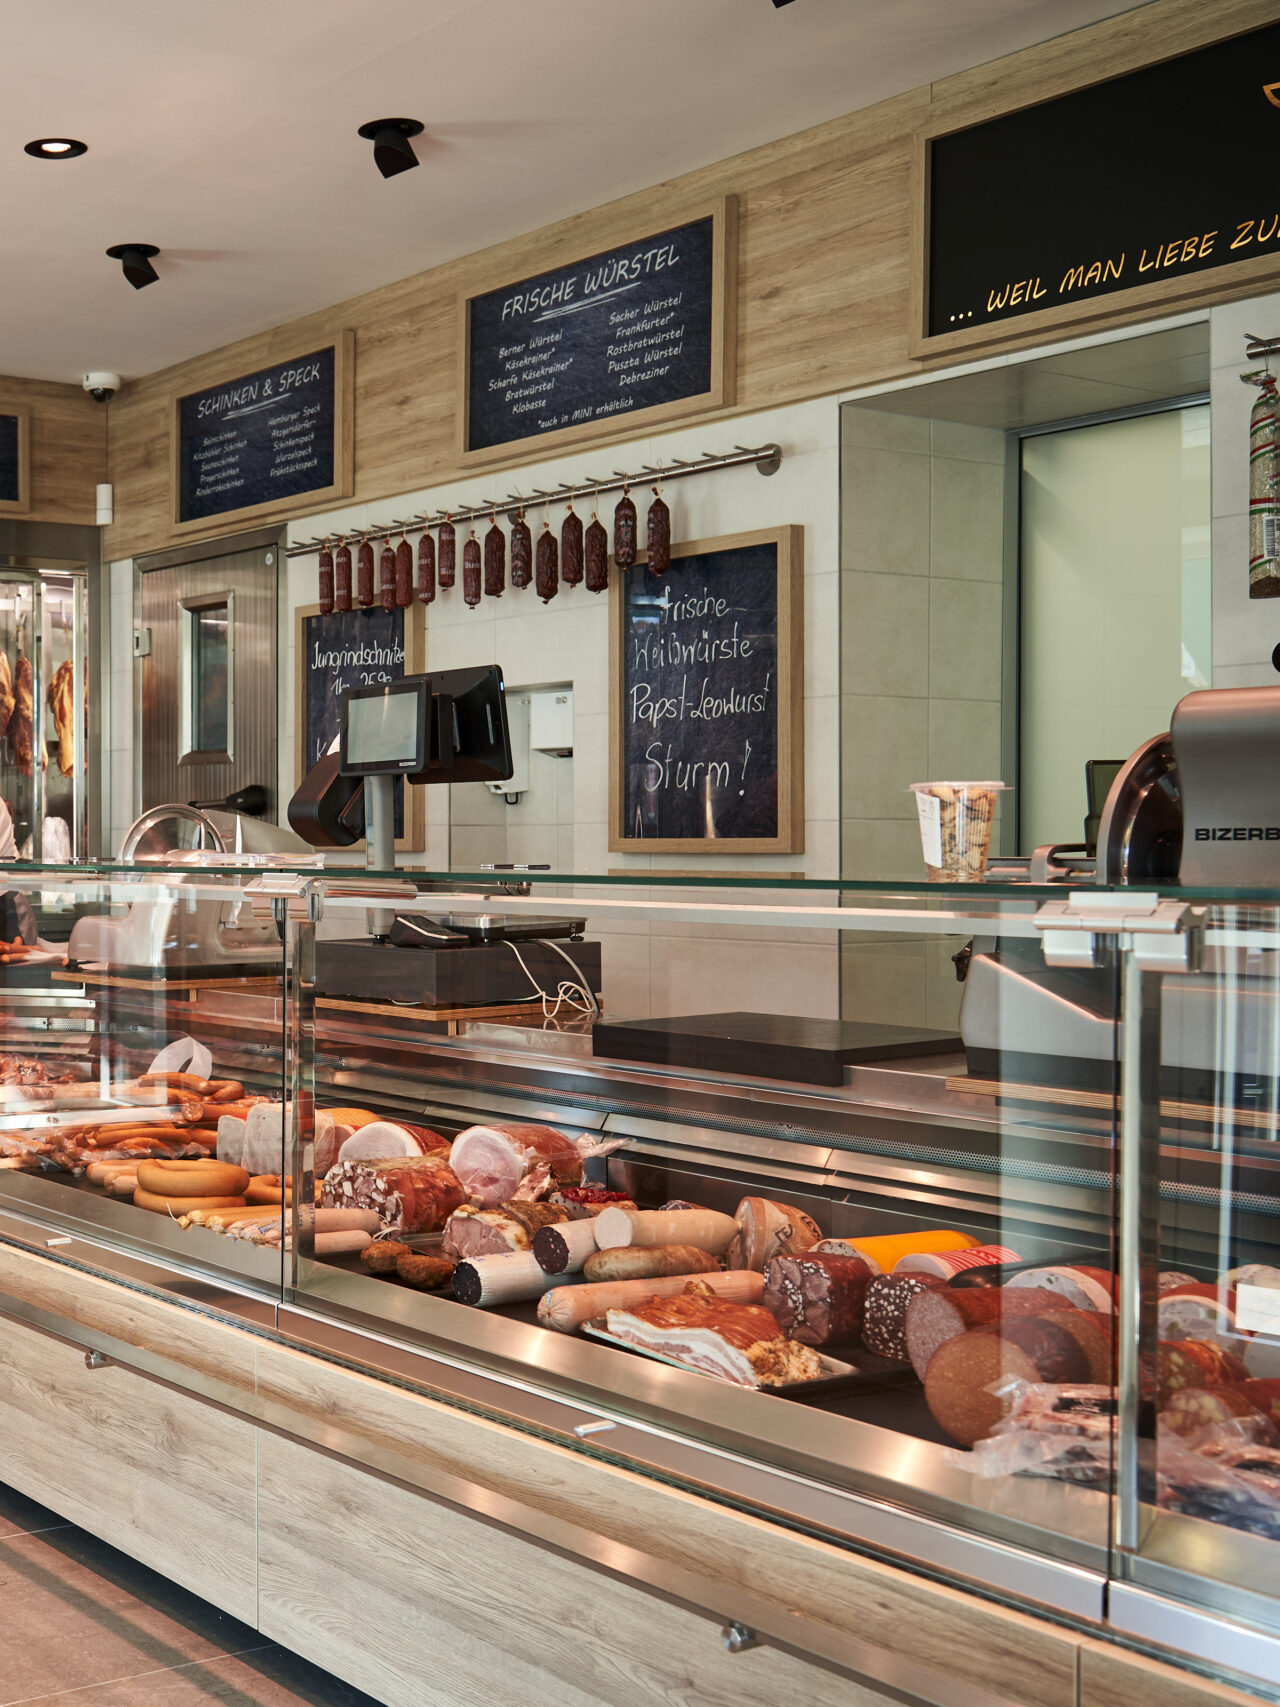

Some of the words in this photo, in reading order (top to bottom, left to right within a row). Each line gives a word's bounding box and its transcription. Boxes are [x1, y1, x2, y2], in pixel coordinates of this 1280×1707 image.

[986, 277, 1047, 312] WEIL
[1059, 253, 1125, 294] MAN
[1138, 230, 1218, 272] LIEBE
[1229, 213, 1280, 250] ZU
[501, 277, 577, 321] FRISCHE
[584, 244, 680, 293] WÜRSTEL
[609, 308, 640, 325] Sacher
[644, 292, 683, 315] Würstel
[498, 342, 526, 359] Berner
[529, 330, 563, 350] Würstel
[606, 325, 685, 357] Rostbratwürstel
[608, 356, 640, 374] Puszta
[644, 343, 683, 364] Würstel
[197, 381, 259, 418] SCHINKEN
[262, 378, 272, 396] &
[278, 363, 320, 392] SPECK
[488, 373, 518, 392] Scharfe
[505, 378, 555, 402] Bratwürstel
[618, 365, 670, 387] Debreziner
[303, 403, 320, 417] Speck
[512, 398, 547, 415] Klobasse
[561, 413, 569, 424] in
[572, 406, 594, 421] MINI
[595, 396, 634, 415] erhältlich
[643, 742, 729, 793] Sturm
[1195, 827, 1280, 841] BIZERB
